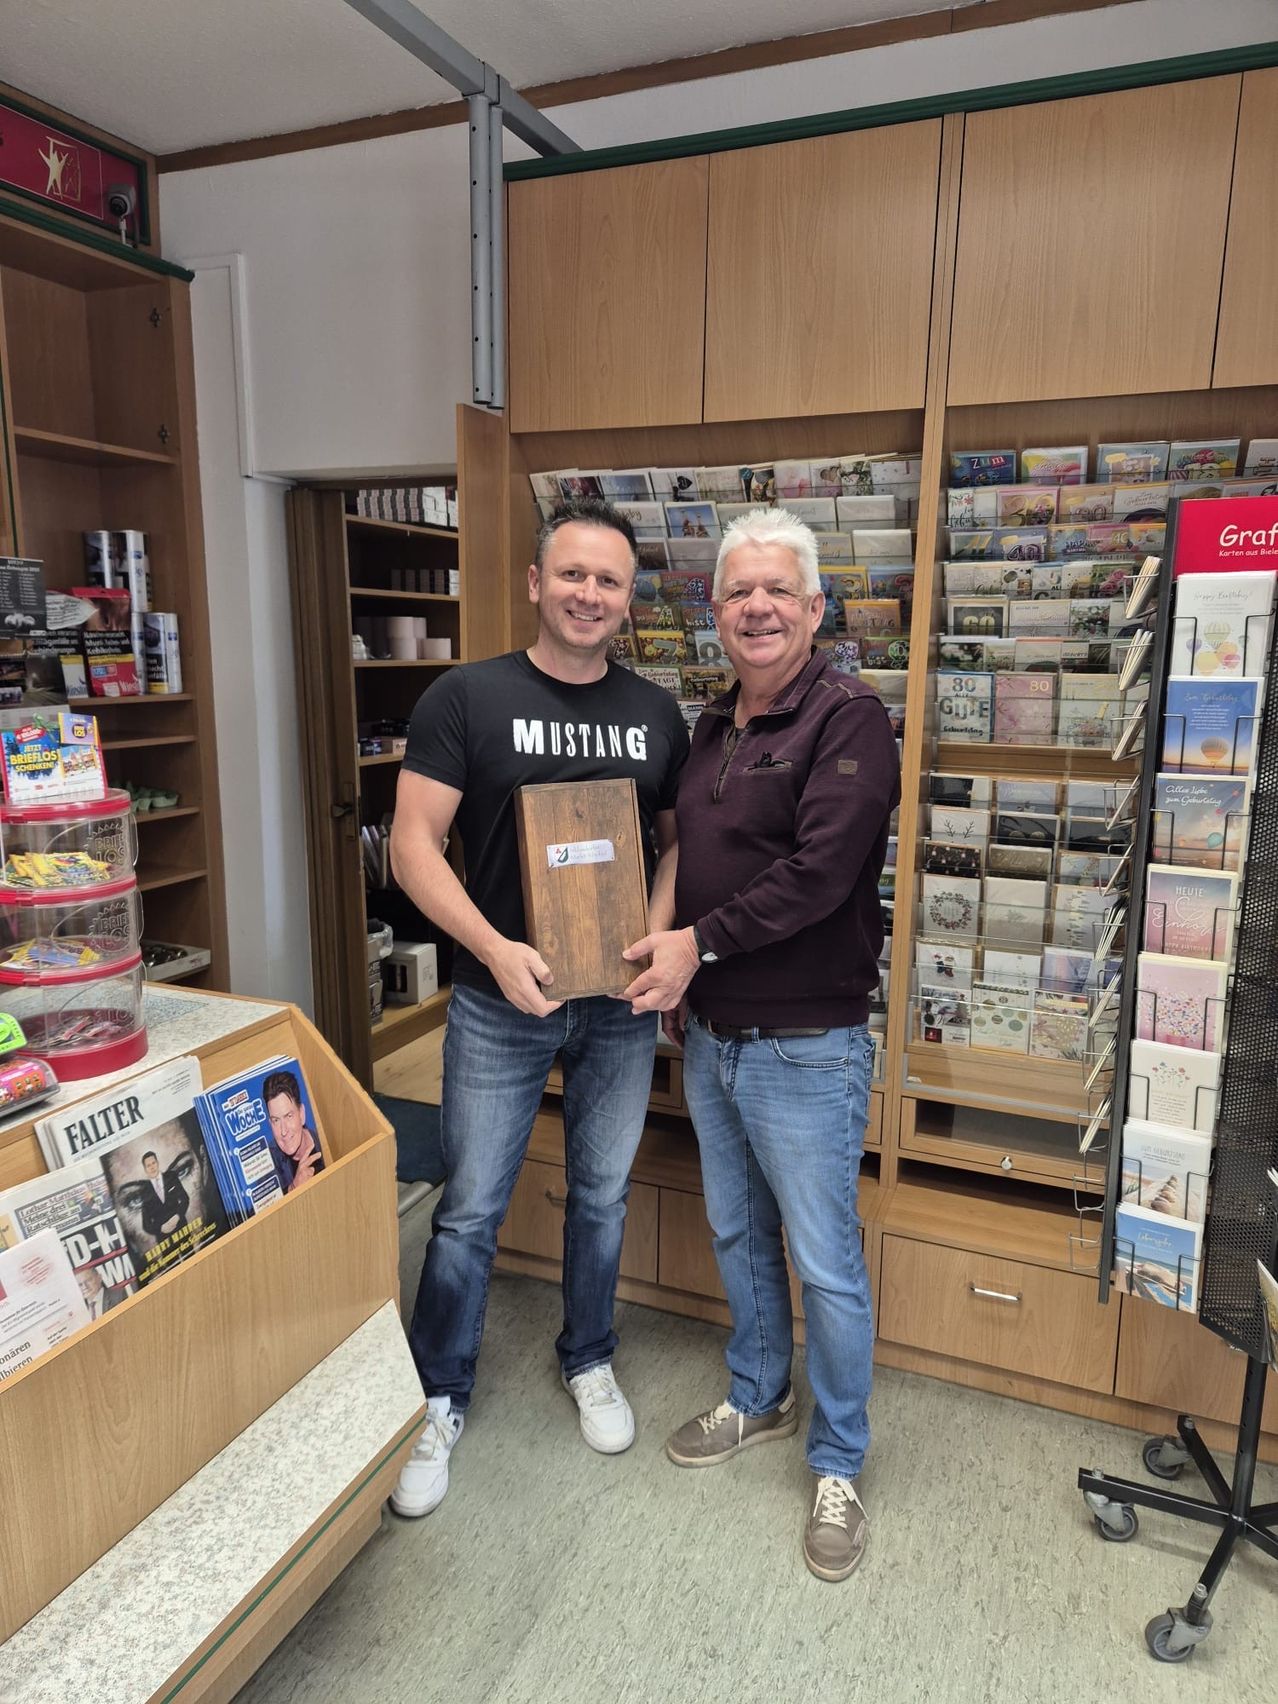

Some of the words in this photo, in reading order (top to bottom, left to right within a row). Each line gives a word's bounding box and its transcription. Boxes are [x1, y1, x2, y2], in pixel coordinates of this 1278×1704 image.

[952, 677, 977, 693] 80
[1030, 680, 1050, 692] 80
[940, 697, 990, 720] GUTE
[943, 725, 984, 737] Geburtstag
[512, 718, 648, 761] MUSTANG
[10, 751, 58, 765] BRIEFLOS
[1175, 885, 1205, 897] HEUTE
[226, 1098, 265, 1135] WOCHE
[64, 1095, 145, 1155] FALTER
